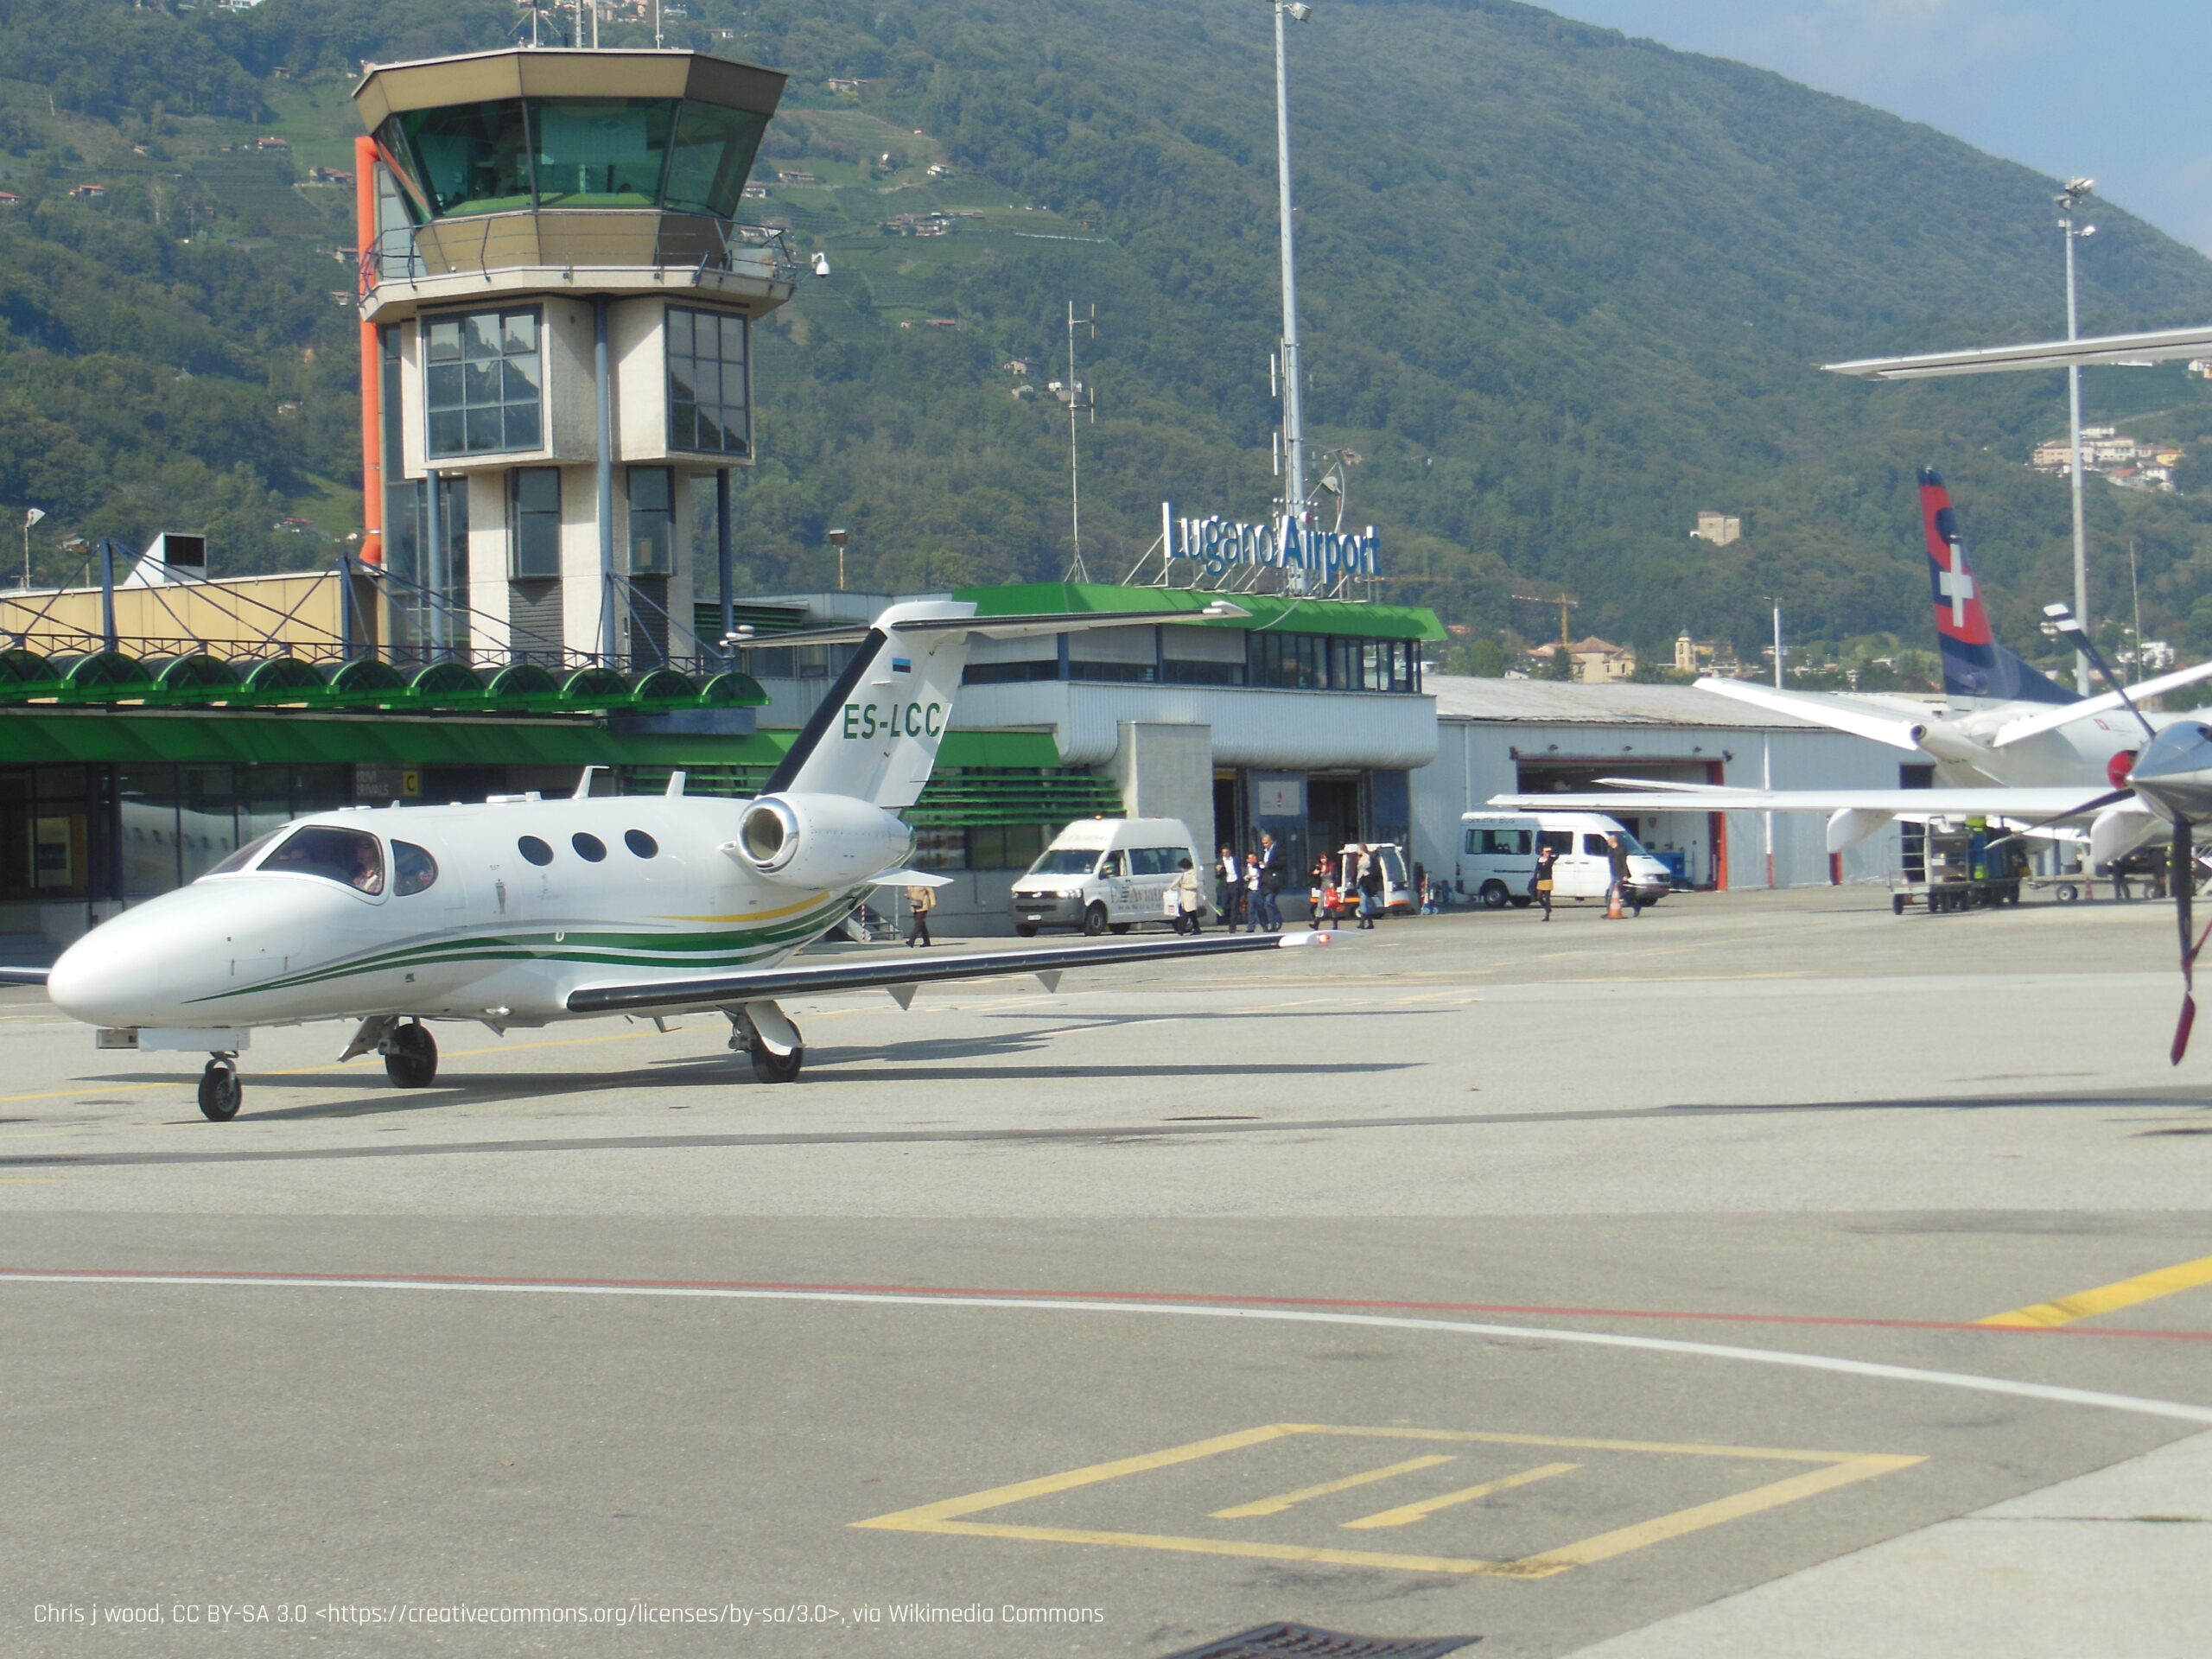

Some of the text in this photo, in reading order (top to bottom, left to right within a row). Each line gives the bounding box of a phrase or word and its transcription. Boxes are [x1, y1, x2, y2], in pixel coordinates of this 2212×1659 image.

[1162, 502, 1380, 584] Lugano Airport
[843, 702, 941, 740] ES-LCC
[406, 774, 415, 791] C
